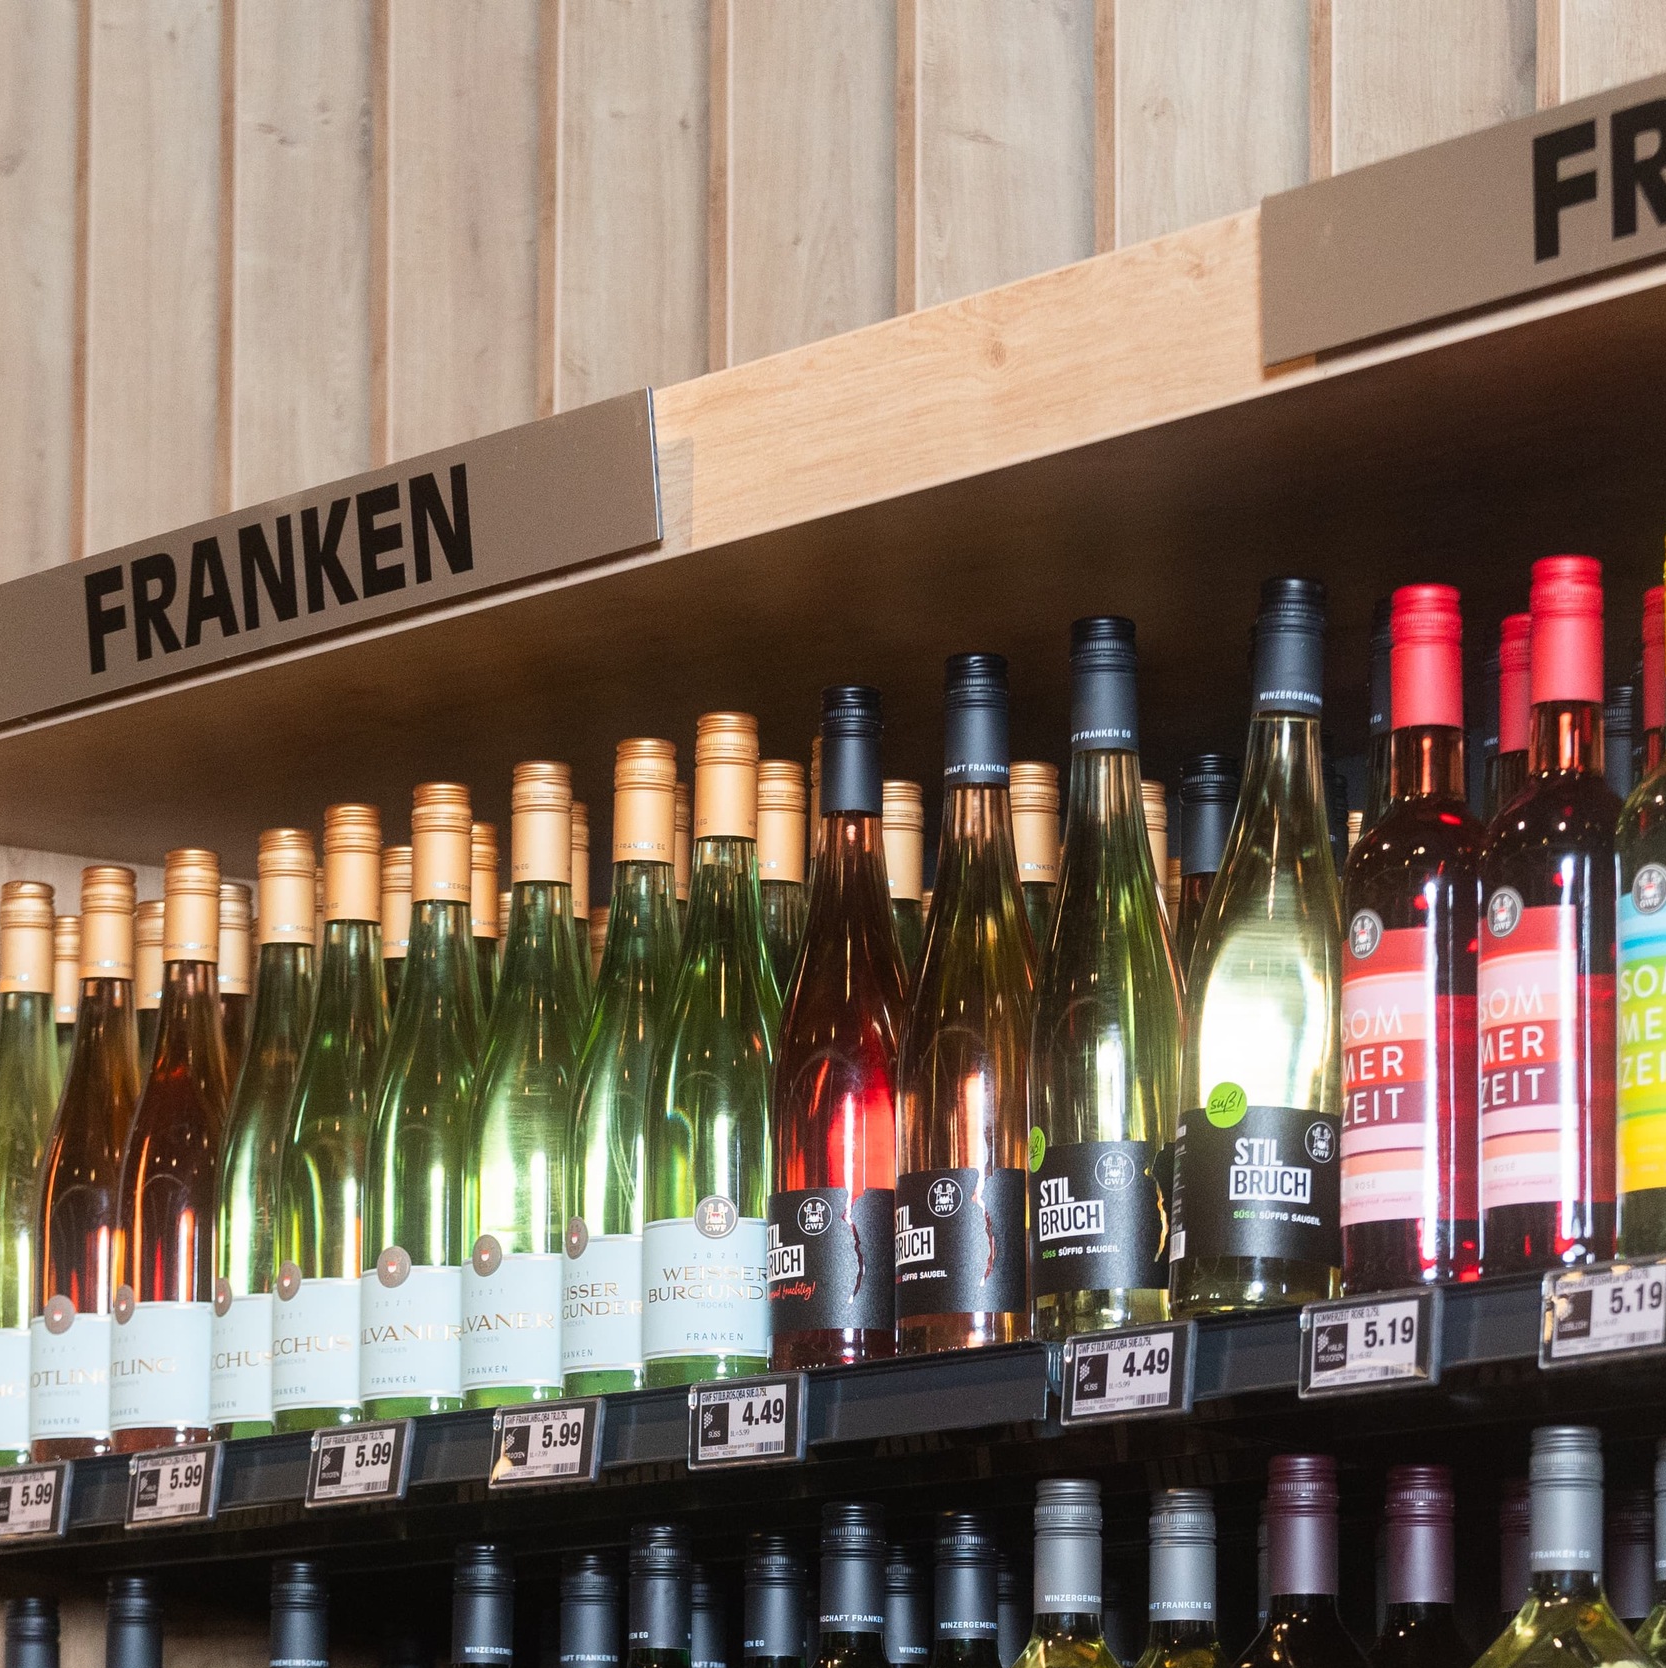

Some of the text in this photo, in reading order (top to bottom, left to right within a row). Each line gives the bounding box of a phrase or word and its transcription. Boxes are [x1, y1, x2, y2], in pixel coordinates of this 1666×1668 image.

[84, 463, 473, 675] FRANKEN
[1210, 1090, 1242, 1113] süß!
[1342, 1088, 1404, 1128] ZEIT
[1235, 1138, 1283, 1166] STIL
[1313, 1149, 1329, 1158] GWF
[1040, 1176, 1075, 1207] STIL
[1105, 1178, 1125, 1186] GWF
[1234, 1170, 1307, 1198] BRUCH
[935, 1204, 955, 1212] GWF
[1233, 1210, 1321, 1226] SÜSS SÜFFIG SAUGEIL
[805, 1223, 823, 1231] GWF
[1042, 1203, 1100, 1237] BRUCH
[1058, 1244, 1119, 1257] SÜFFIG SAUGEIL
[663, 1266, 767, 1282] WEISSER
[768, 1250, 801, 1276] RUCH
[920, 1270, 947, 1279] SAUGEIL
[648, 1284, 767, 1303] BURGUND
[696, 1301, 734, 1309] TROCKEN
[1609, 1280, 1663, 1316] 5.19
[686, 1333, 743, 1341] FRANKEN
[1363, 1316, 1415, 1350] 5.19
[468, 1365, 508, 1374] FRANKEN
[1122, 1348, 1170, 1378] 4.49
[372, 1376, 416, 1385] FRANKEN
[742, 1398, 784, 1426] 4.49
[542, 1422, 581, 1448] 5.99
[356, 1442, 391, 1468] 5.99
[170, 1464, 202, 1490] 5.99
[21, 1483, 52, 1506] 5.99
